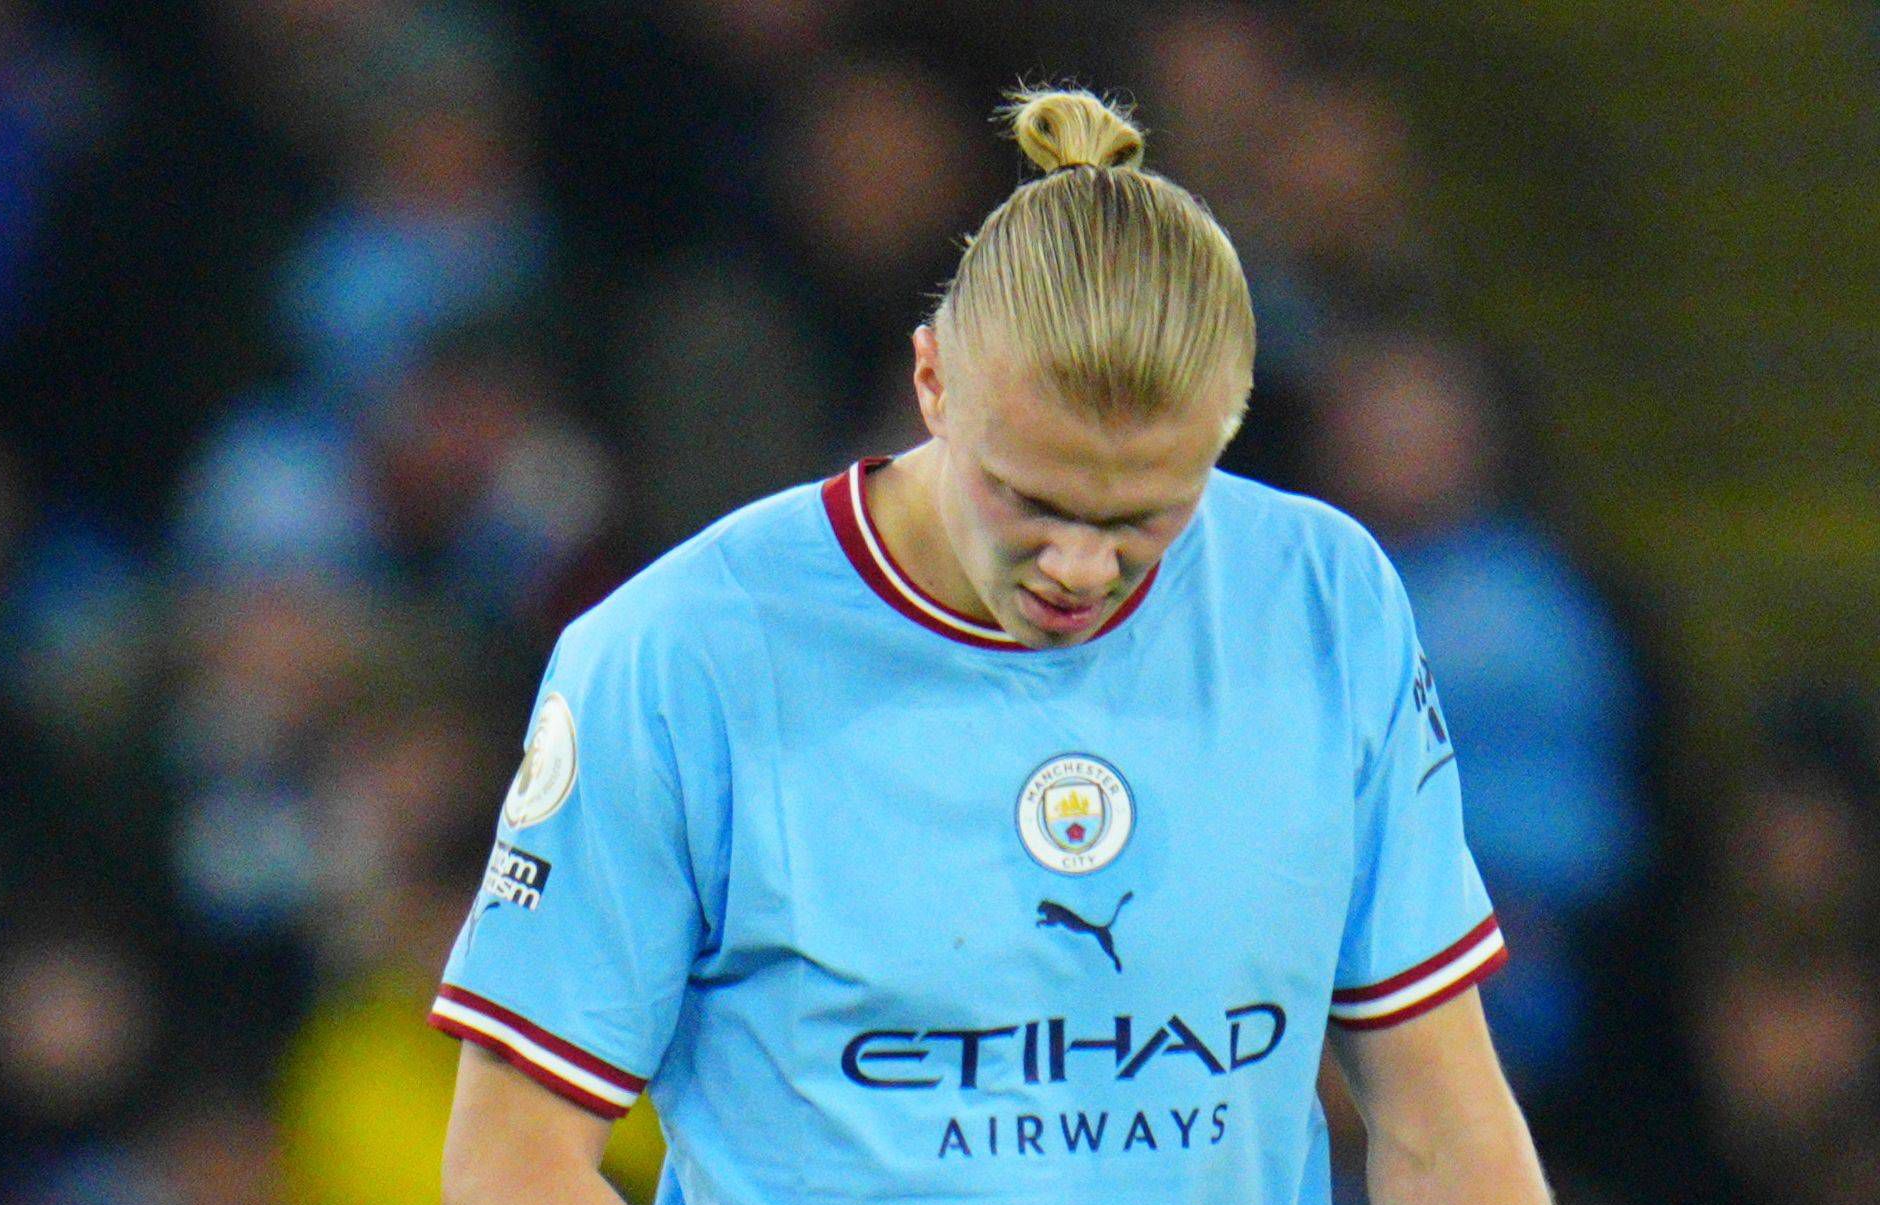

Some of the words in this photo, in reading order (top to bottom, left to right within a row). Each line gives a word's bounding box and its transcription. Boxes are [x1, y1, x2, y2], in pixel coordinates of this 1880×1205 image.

[1027, 761, 1120, 802] MANCHESTER
[1062, 854, 1095, 868] CITY
[840, 1002, 1287, 1090] ETIHAD
[938, 1103, 1229, 1159] AIRWAYS
